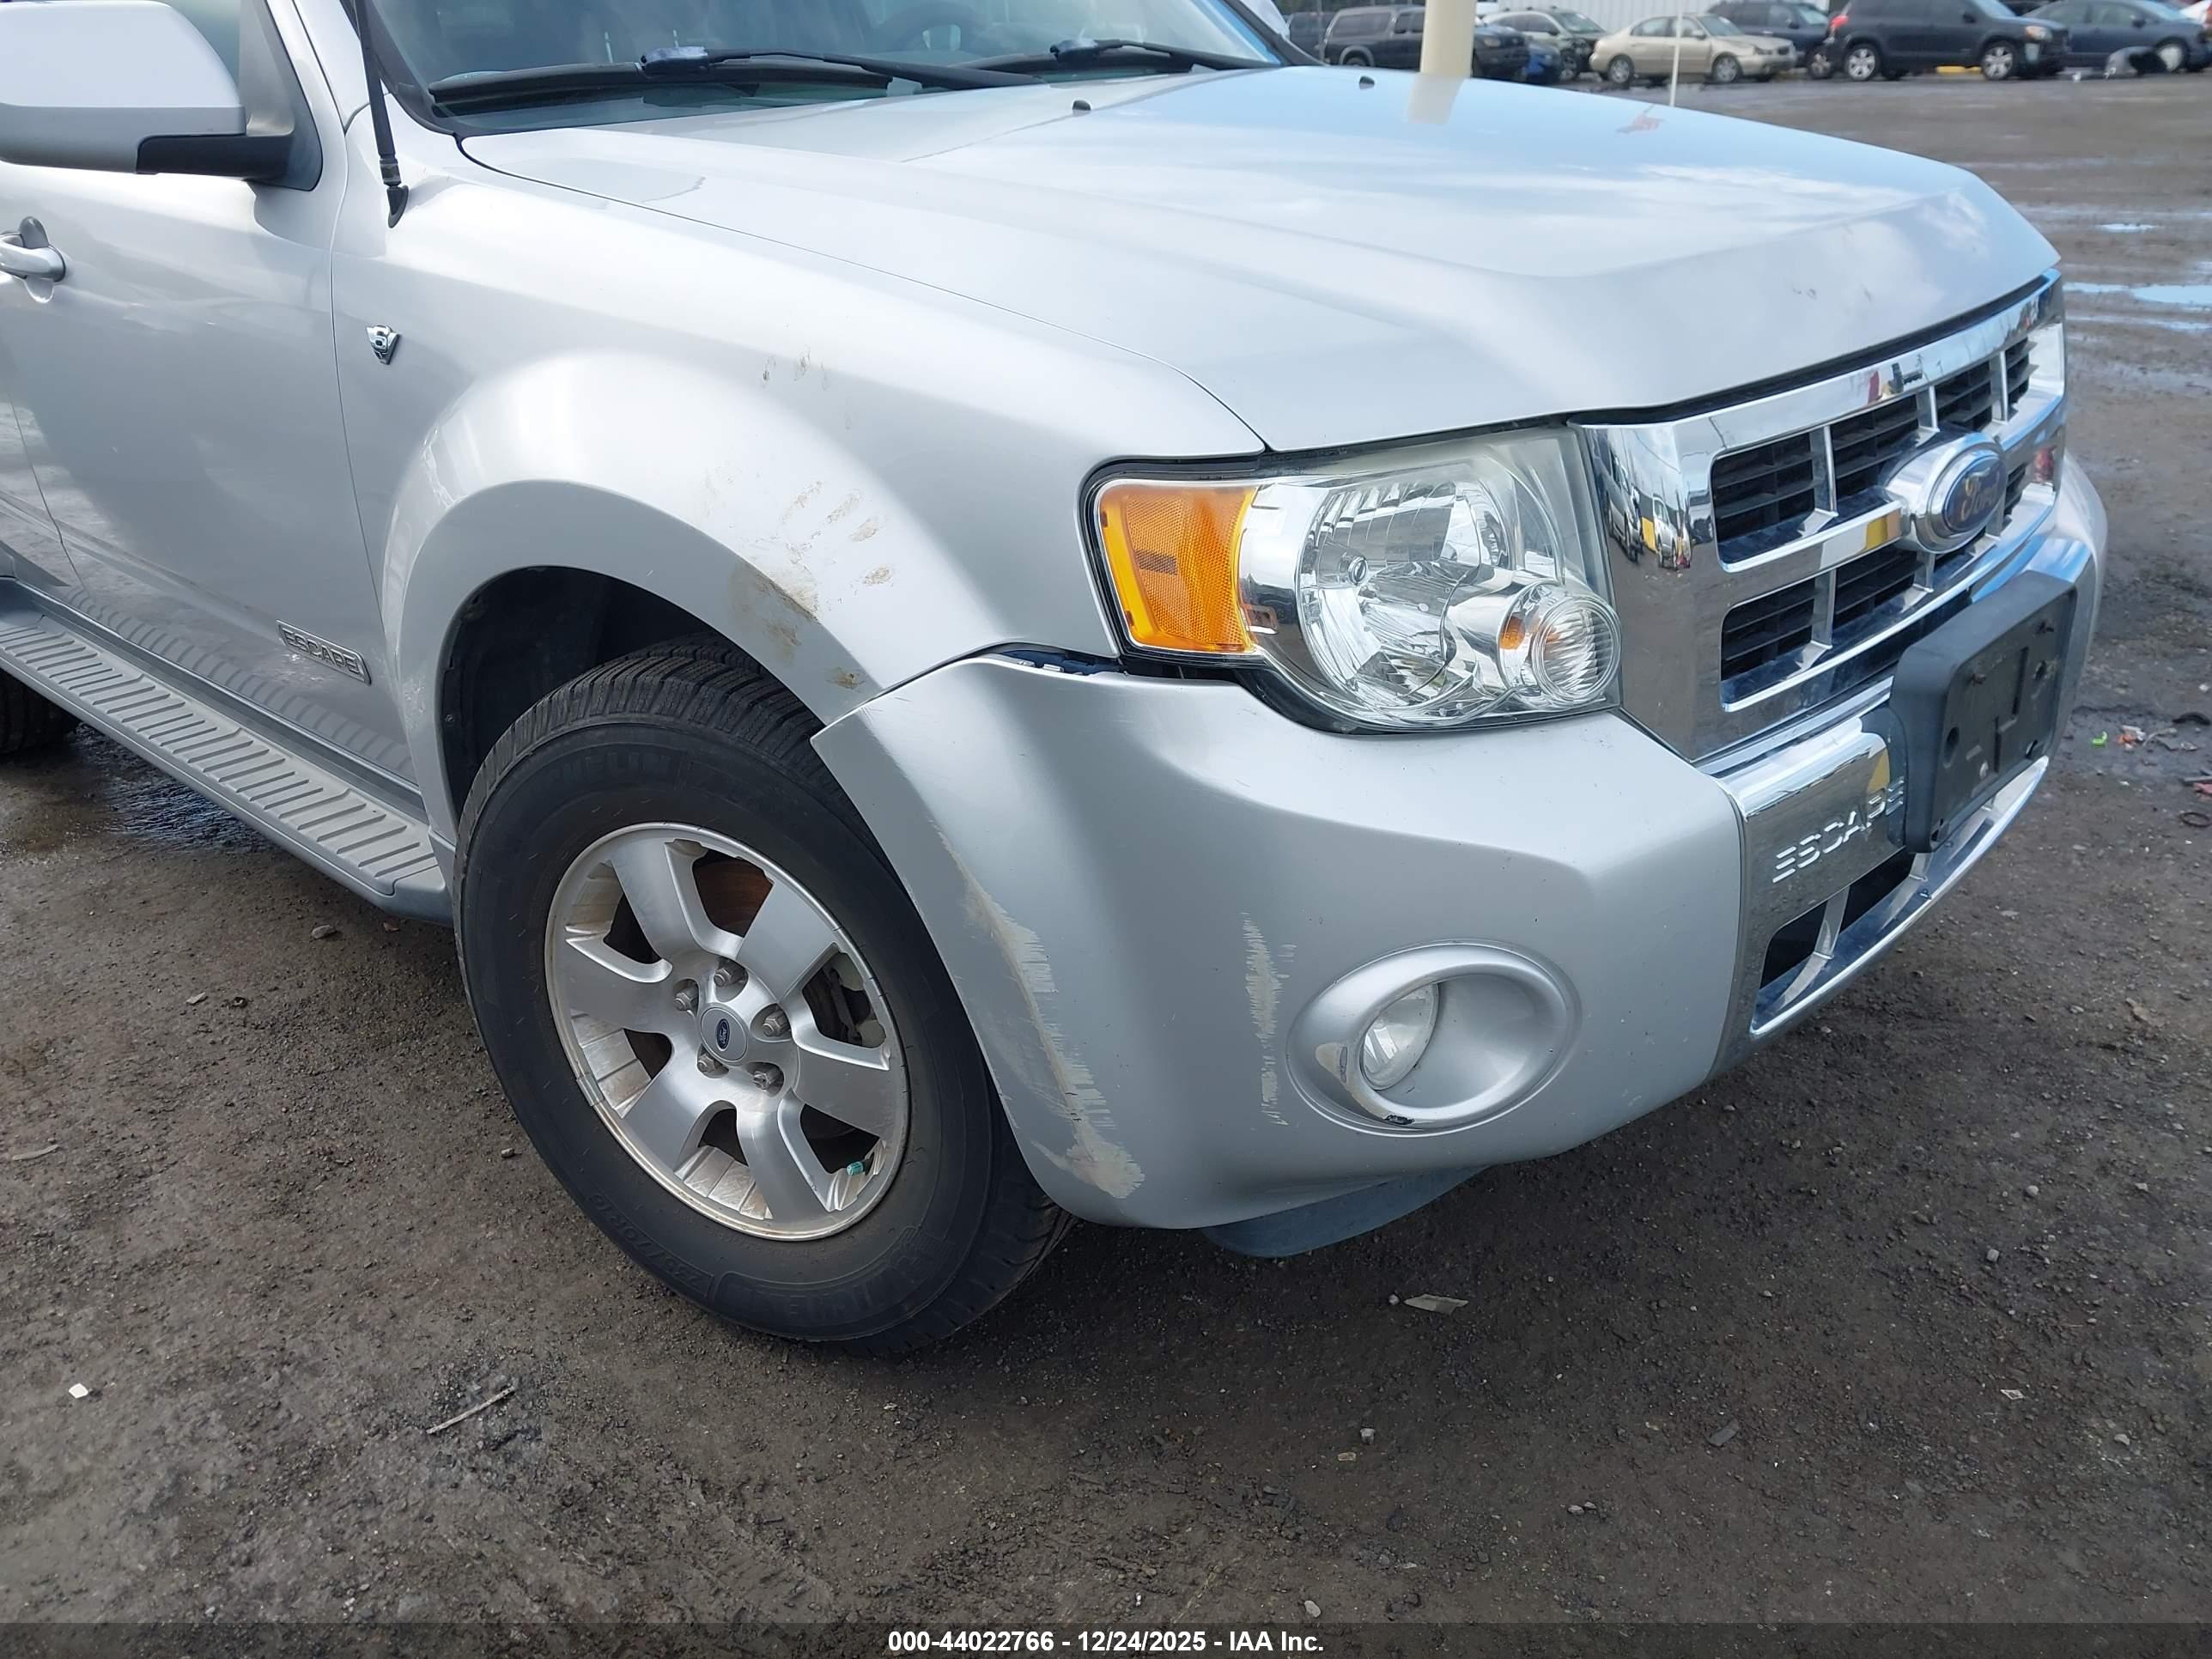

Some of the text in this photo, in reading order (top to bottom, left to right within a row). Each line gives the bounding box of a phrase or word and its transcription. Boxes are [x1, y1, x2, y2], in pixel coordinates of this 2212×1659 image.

[1960, 466, 2000, 521] Ford
[283, 628, 361, 675] ESCAPE
[1772, 776, 1905, 884] ESCAPE
